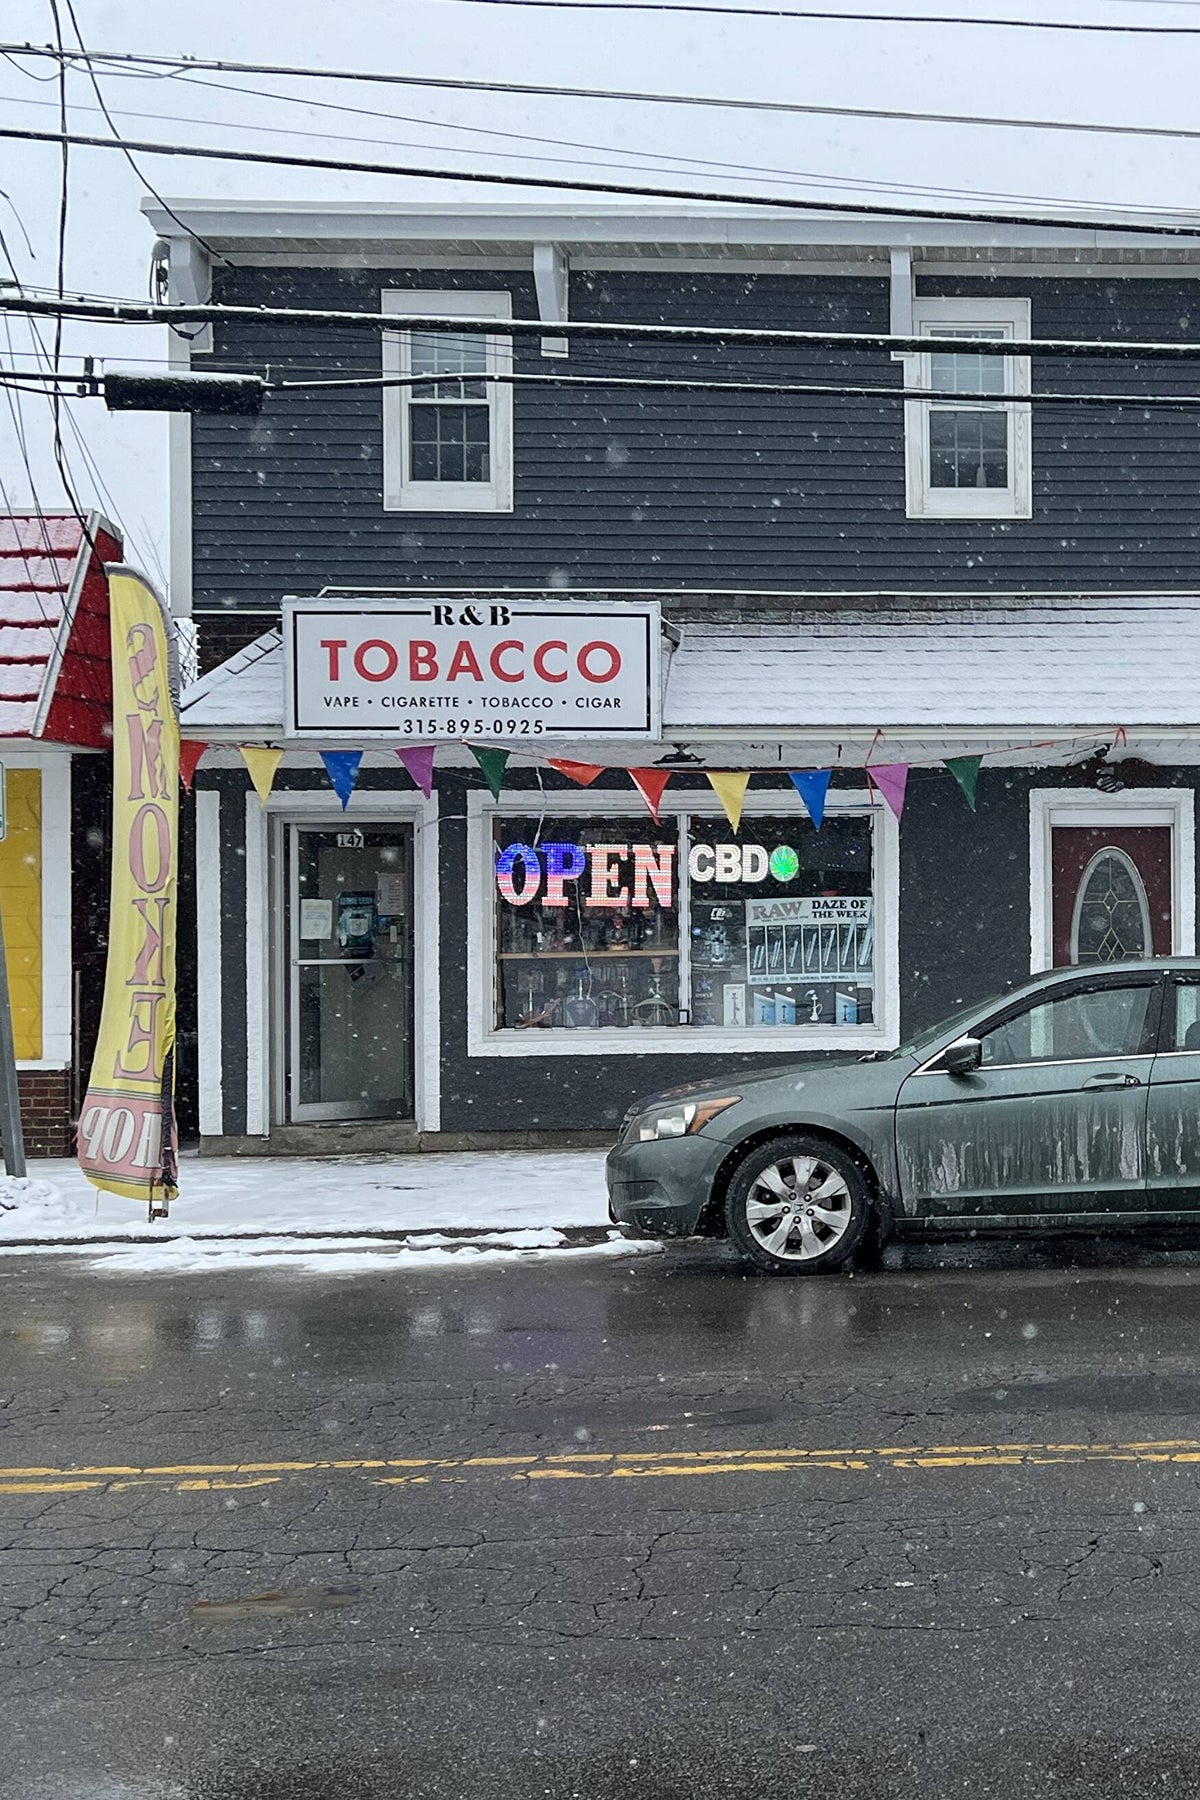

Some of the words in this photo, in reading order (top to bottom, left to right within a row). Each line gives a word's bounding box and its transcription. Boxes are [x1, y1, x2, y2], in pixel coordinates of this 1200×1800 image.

[431, 604, 511, 627] R&B
[320, 638, 623, 684] TOBACCO
[323, 696, 360, 709] VAPE
[380, 695, 460, 709] CIGARETTE
[480, 696, 554, 709] TOBACCO
[574, 697, 622, 710] CIGAR
[403, 718, 544, 735] 315-895-0925
[339, 835, 362, 847] 147
[687, 843, 769, 883] CBD
[496, 842, 676, 908] OPEN
[751, 901, 804, 921] RAW
[811, 899, 848, 910] DAZE
[850, 899, 868, 910] OF
[811, 910, 835, 919] THE
[835, 910, 868, 919] WEEK
